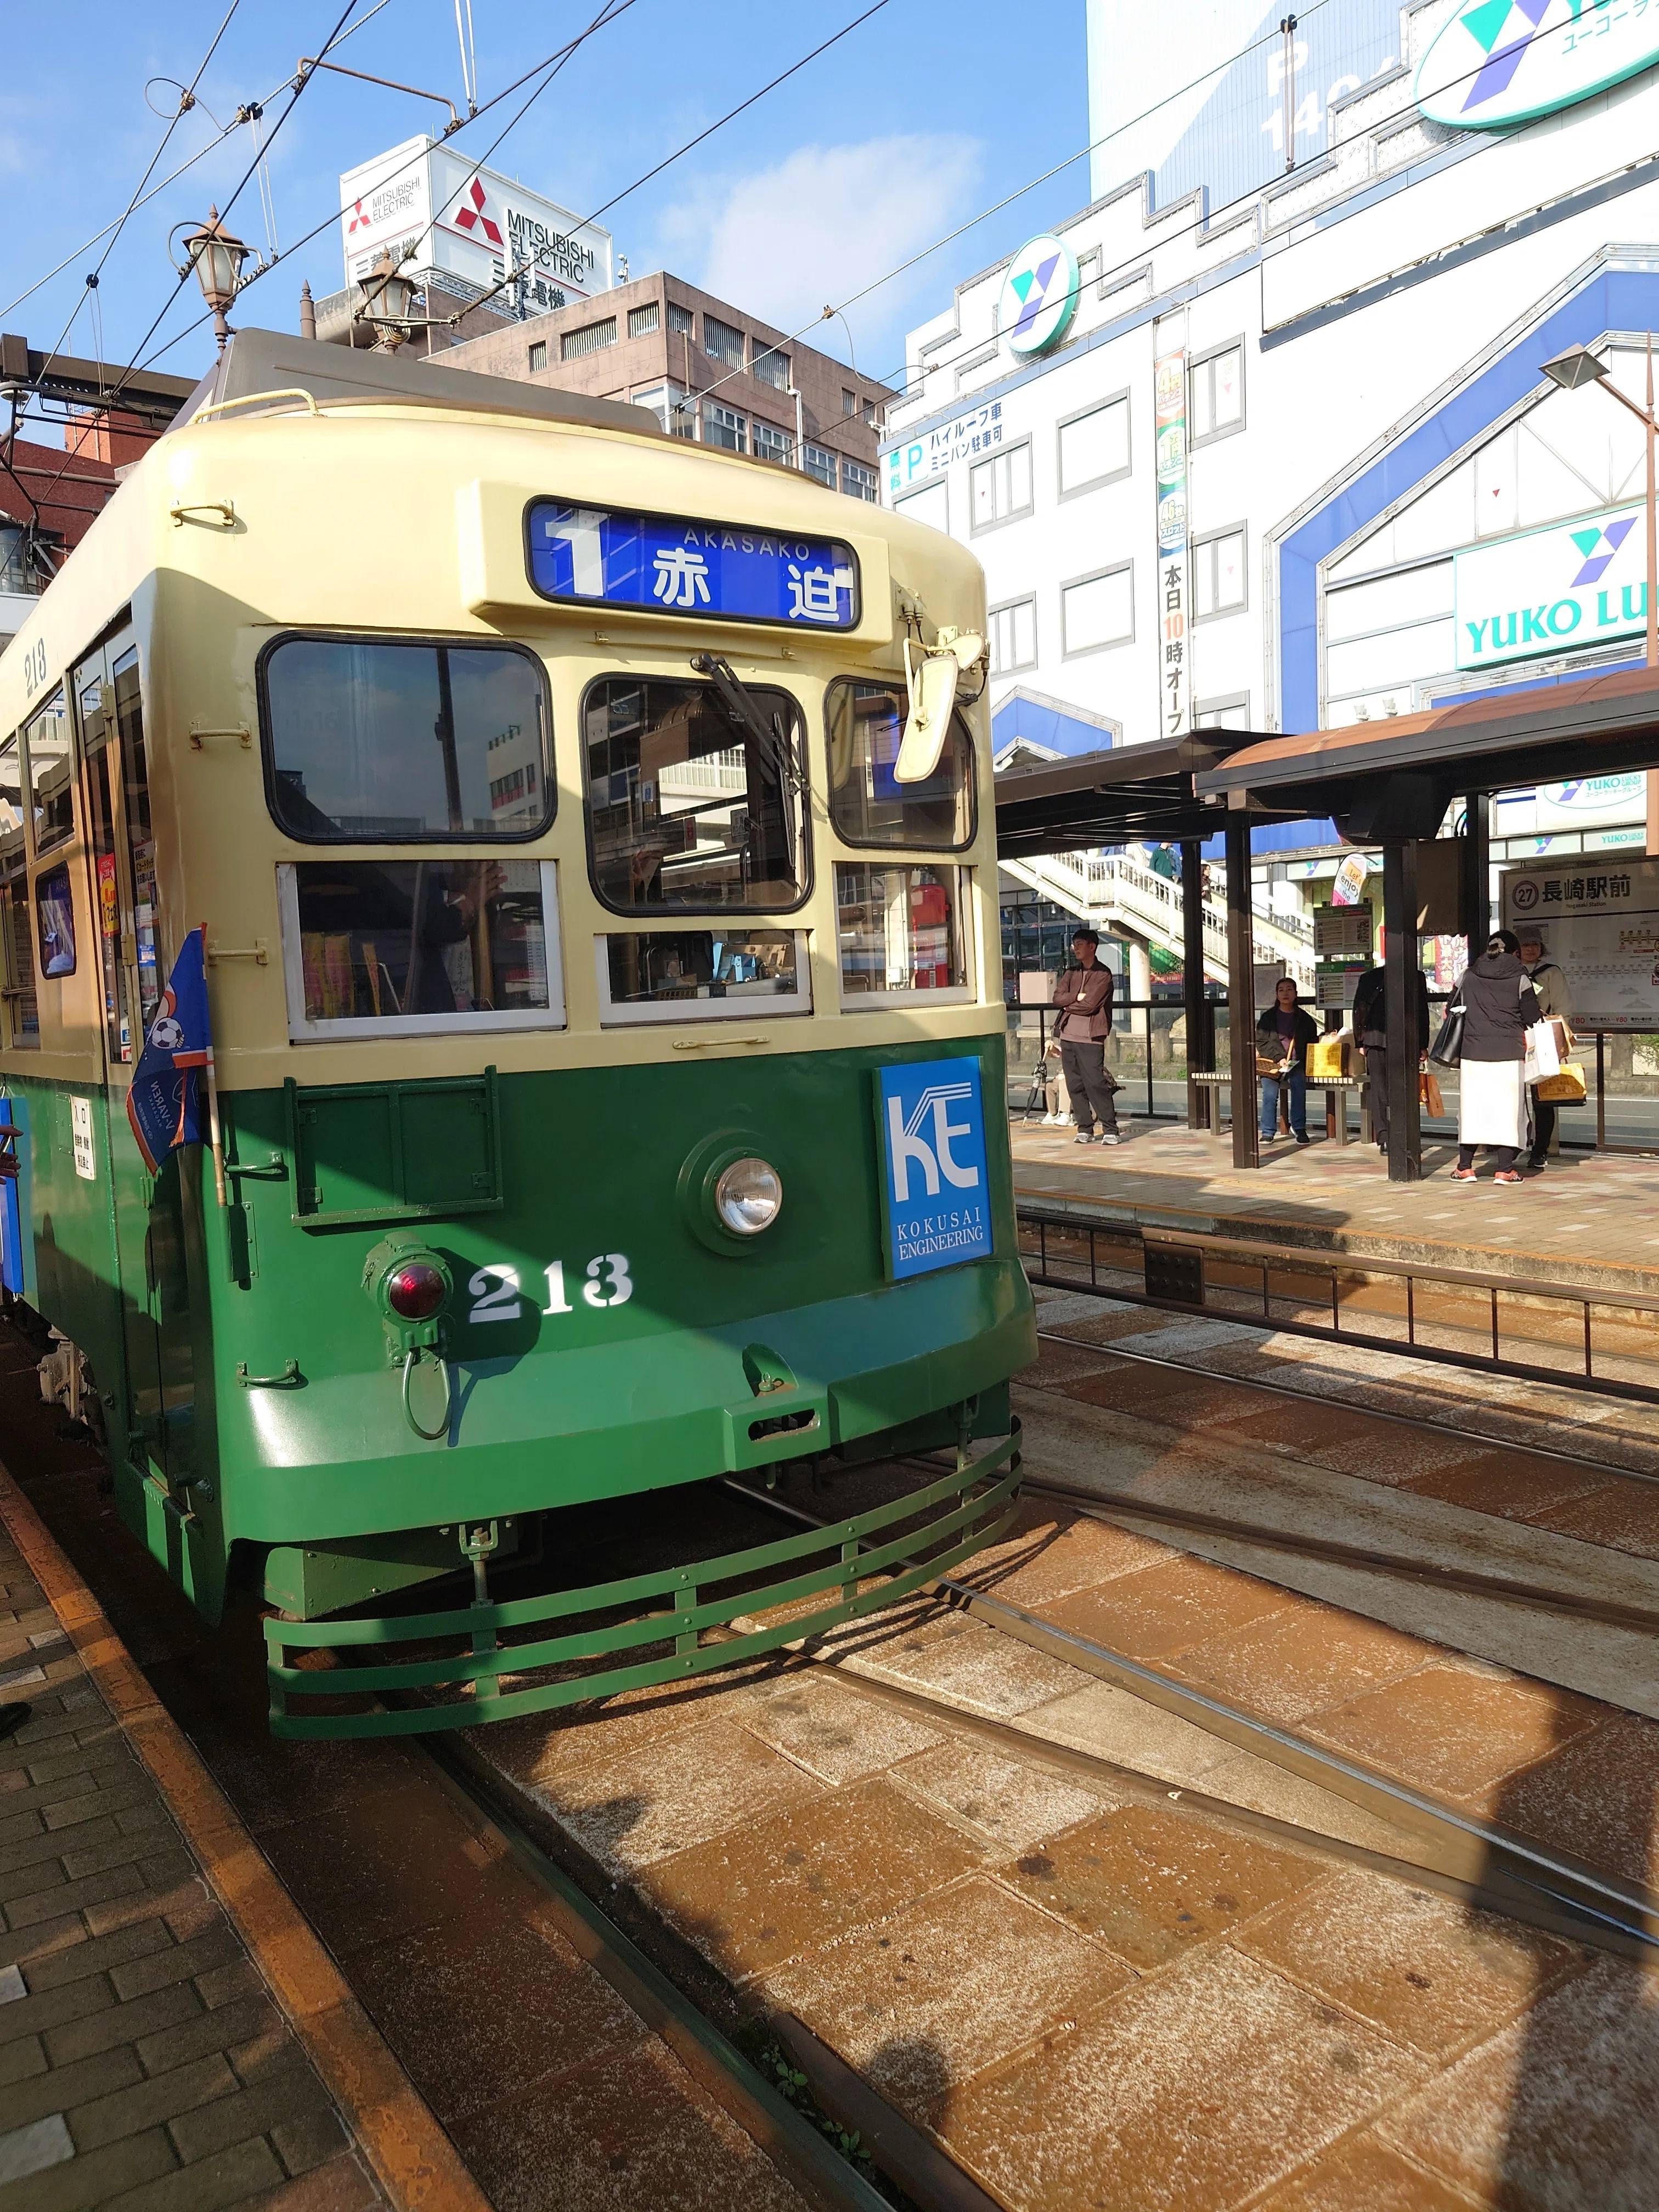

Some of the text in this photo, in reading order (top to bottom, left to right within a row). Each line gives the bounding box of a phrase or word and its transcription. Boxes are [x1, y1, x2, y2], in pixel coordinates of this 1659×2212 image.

[1562, 0, 1659, 55] ユーコーラ
[373, 176, 420, 208] MITSUBISHI
[373, 193, 414, 221] ELECTRIC
[507, 208, 594, 269] MITSUBISHI
[509, 230, 584, 284] ELECTRIC
[931, 402, 1002, 450] ハイルーフ車
[908, 444, 923, 481] P
[931, 424, 1003, 471] ミニバン駐車可
[545, 509, 603, 596] 1
[684, 527, 810, 561] AKASAKO
[1465, 582, 1659, 653] YUKO LU
[25, 637, 47, 698] 213
[1585, 777, 1621, 791] YUKO
[1601, 834, 1628, 843] YUKO
[1341, 875, 1358, 897] enjoy
[1342, 888, 1351, 901] the
[1518, 889, 1532, 902] 27
[1543, 874, 1631, 903] 長崎駅前
[75, 1105, 86, 1124] 入口
[897, 1206, 981, 1242] KOKUSAI
[899, 1225, 984, 1261] ENGINEERING
[469, 1254, 634, 1324] 213
